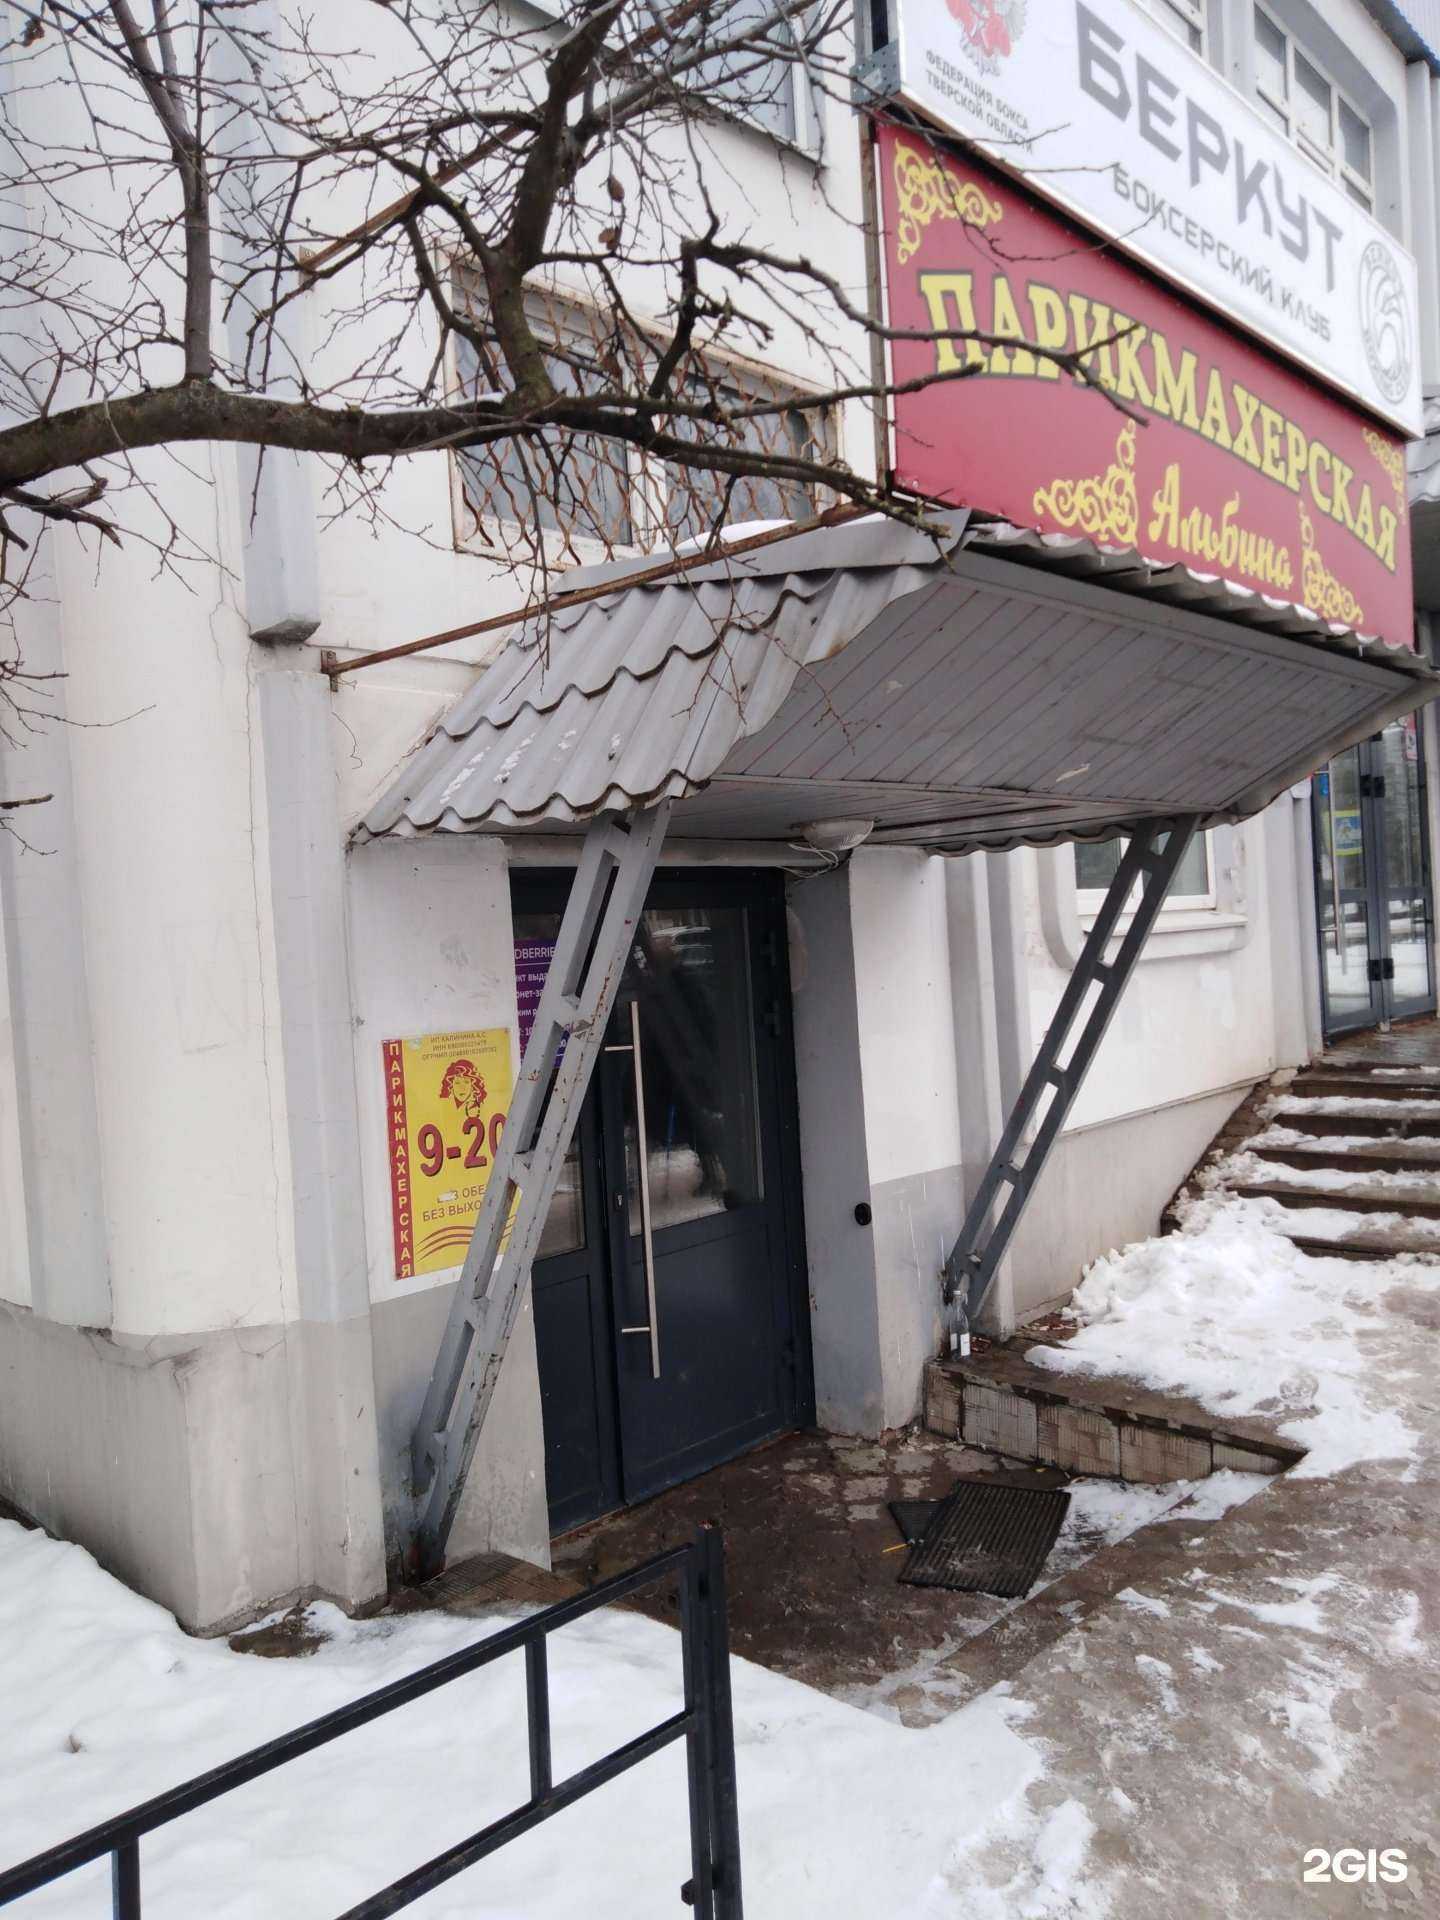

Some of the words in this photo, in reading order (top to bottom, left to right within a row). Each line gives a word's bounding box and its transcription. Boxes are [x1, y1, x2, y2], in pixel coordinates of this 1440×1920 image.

[926, 49, 993, 107] ФЕДЕРАЦИЯ
[996, 98, 1028, 129] БОКСА
[926, 68, 984, 120] ТВЕРСКОЙ
[986, 112, 1032, 155] ОБЛАСТИ
[1075, 1, 1344, 293] БЕРКУТ
[1113, 163, 1273, 303] БОКСЕРСКИЙ
[1282, 286, 1331, 343] КЛУБ
[918, 269, 1397, 575] ПАРИКМАХЕРСКАЯ
[1148, 462, 1294, 591] Альбина
[388, 1041, 412, 1278] ПАРИКМАХЕРСКАЯ
[417, 1112, 507, 1177] 9-20
[462, 1184, 486, 1199] ОБЕ
[423, 1206, 446, 1222] БЕЗ
[448, 1199, 482, 1217] ВЫХО
